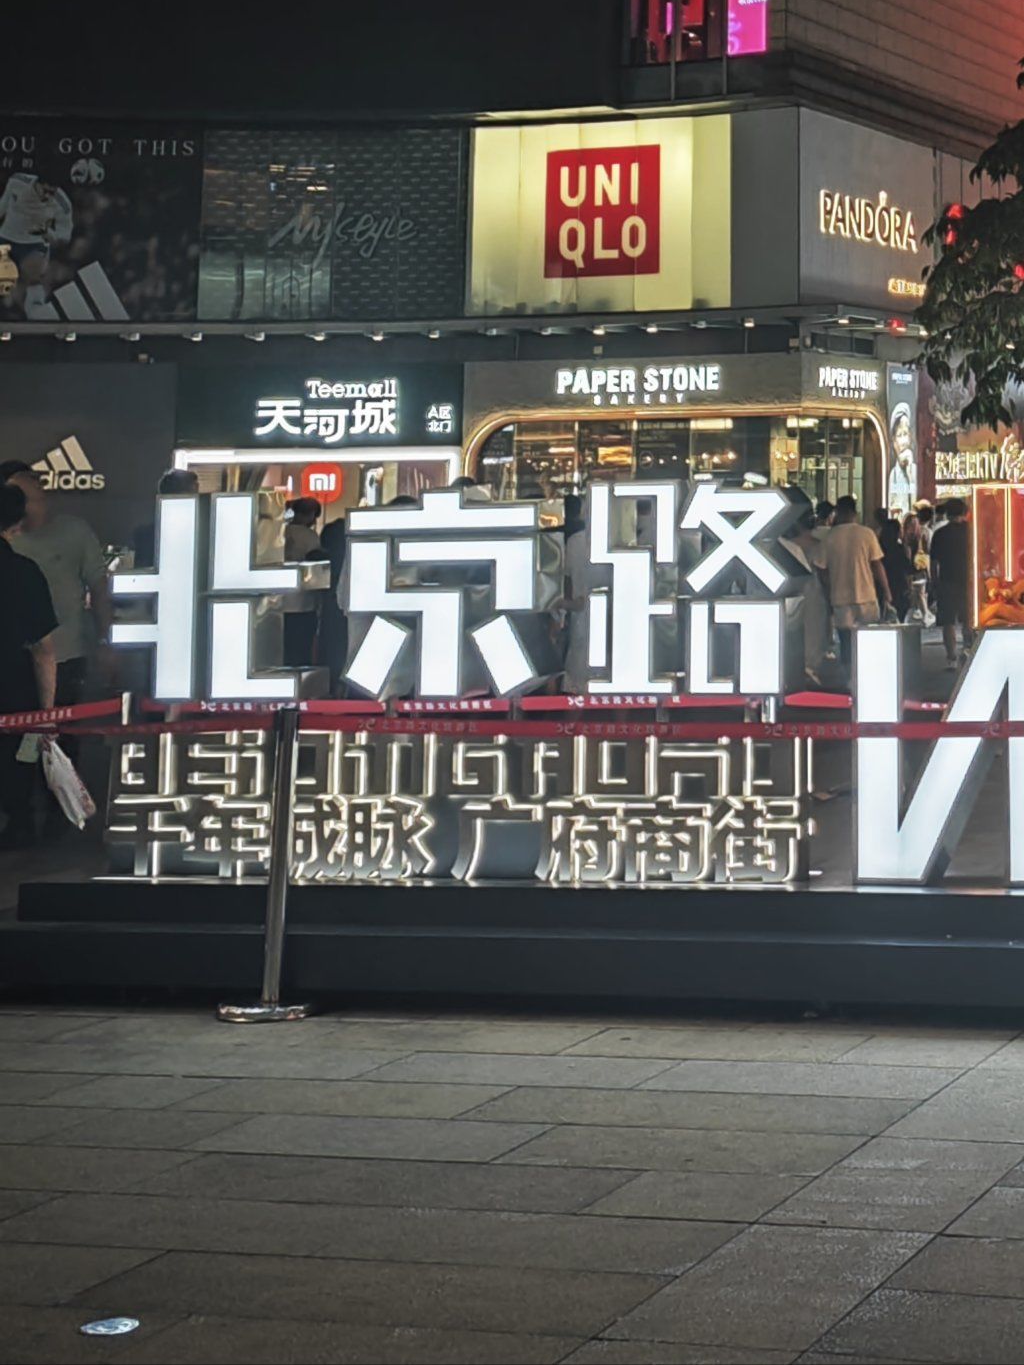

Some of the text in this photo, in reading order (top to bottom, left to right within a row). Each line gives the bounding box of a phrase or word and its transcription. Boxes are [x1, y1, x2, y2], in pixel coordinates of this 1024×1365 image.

[59, 137, 112, 154] GOT
[133, 139, 195, 156] THIS
[559, 162, 640, 208] UNI
[818, 189, 918, 254] PANDORA
[557, 215, 648, 269] QLO
[306, 378, 397, 399] Teemall
[557, 365, 720, 395] PAPER STONE
[818, 366, 849, 388] PAPER
[849, 368, 878, 391] STONE
[254, 398, 397, 443] 天河城
[39, 470, 105, 490] didas
[110, 480, 786, 700] 北京路
